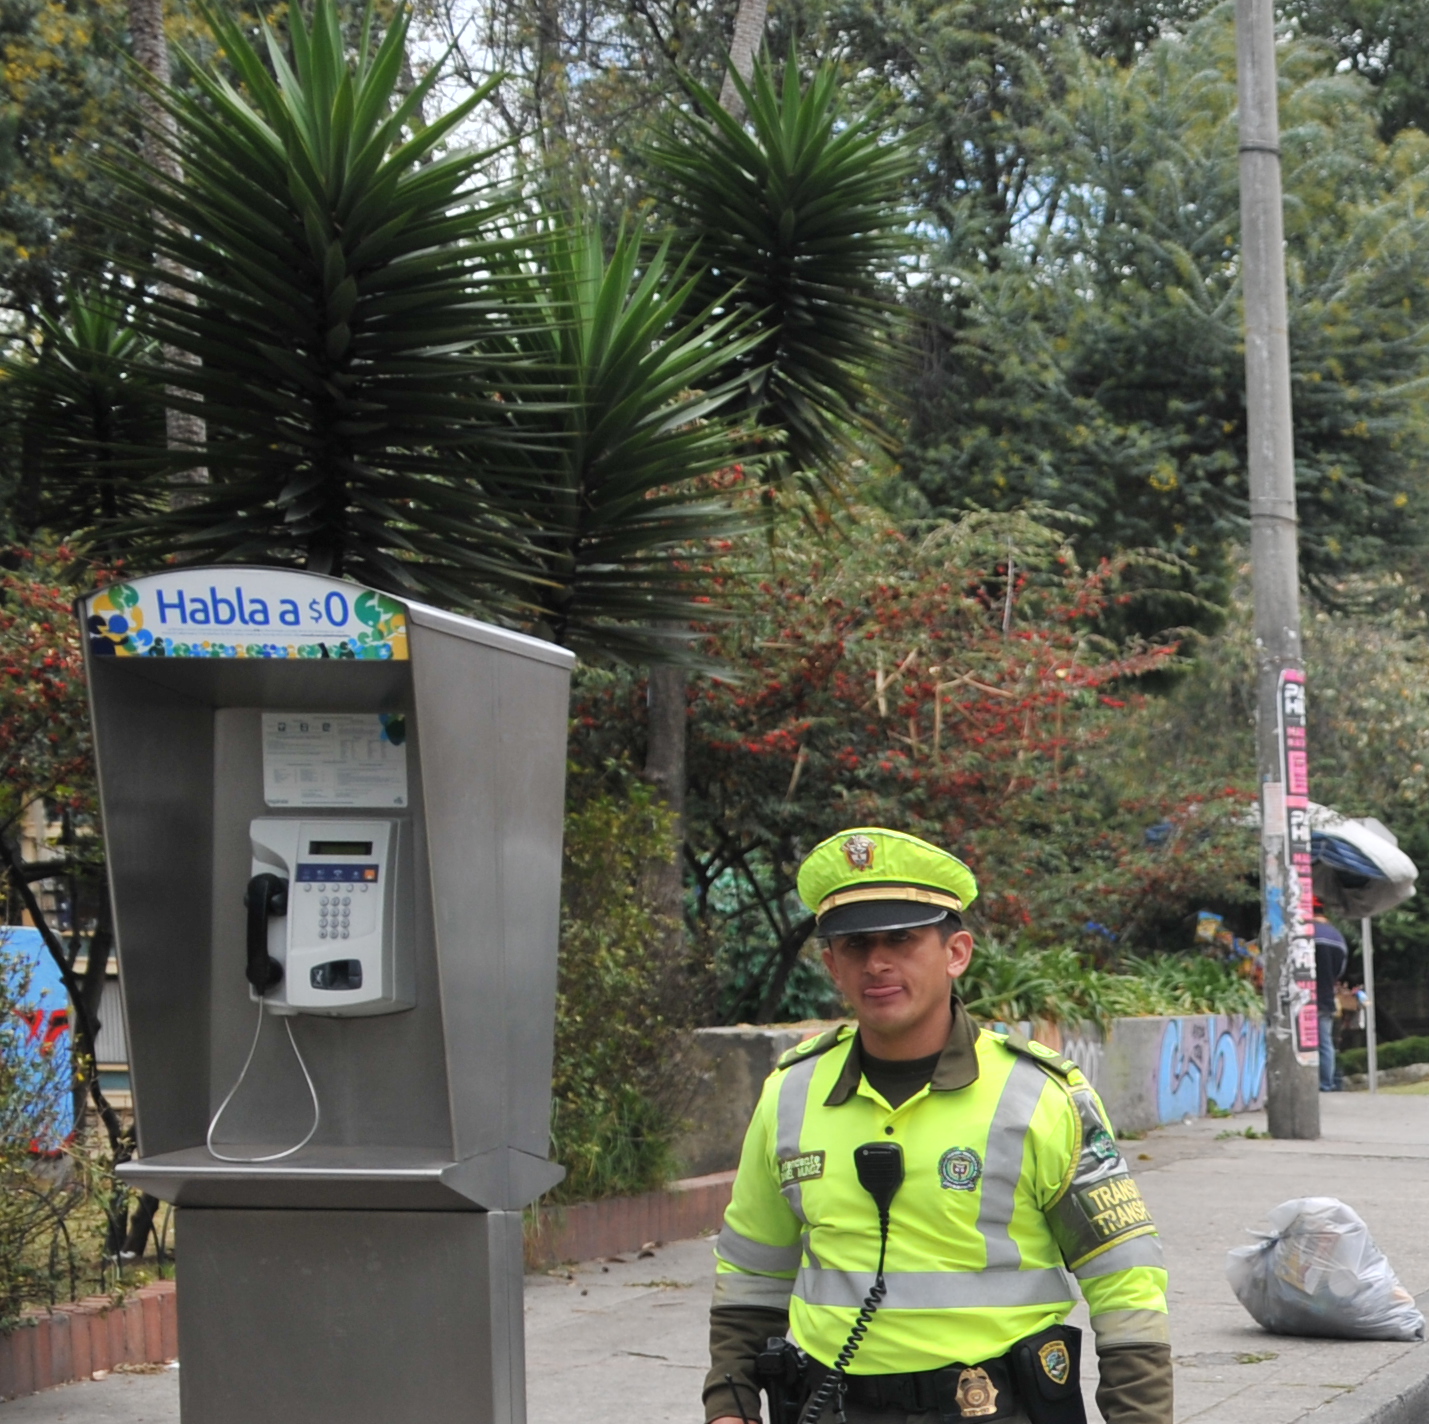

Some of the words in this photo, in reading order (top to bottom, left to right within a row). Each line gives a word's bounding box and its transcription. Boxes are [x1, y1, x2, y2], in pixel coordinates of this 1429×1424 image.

[156, 587, 270, 626] Habla
[279, 598, 301, 626] a
[309, 591, 349, 627] $0
